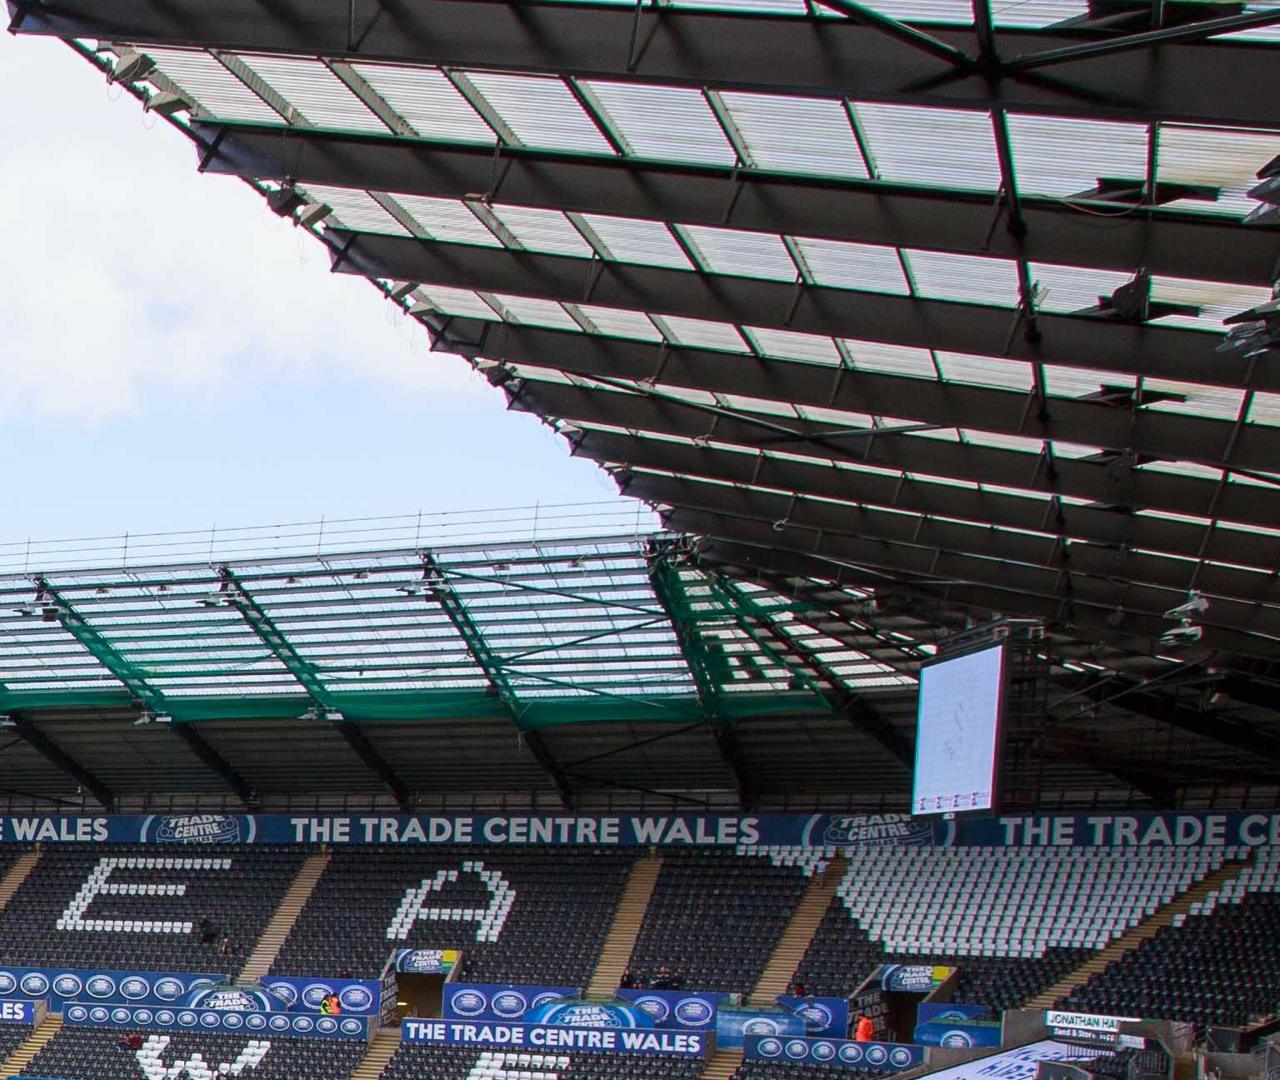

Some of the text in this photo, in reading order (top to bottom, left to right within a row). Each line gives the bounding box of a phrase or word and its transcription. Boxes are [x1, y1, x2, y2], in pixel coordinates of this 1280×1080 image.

[11, 818, 109, 841] WALES
[173, 822, 221, 838] CENTRE
[291, 818, 759, 844] THE TRADE CENTRE WALES
[846, 822, 910, 840] CENTRE
[1000, 817, 1075, 845] THE
[1088, 816, 1227, 846] TRADE
[573, 1006, 602, 1015] THE
[1051, 1014, 1099, 1027] JONATHAN
[407, 1022, 700, 1053] THE TRADE CENTRE WALES
